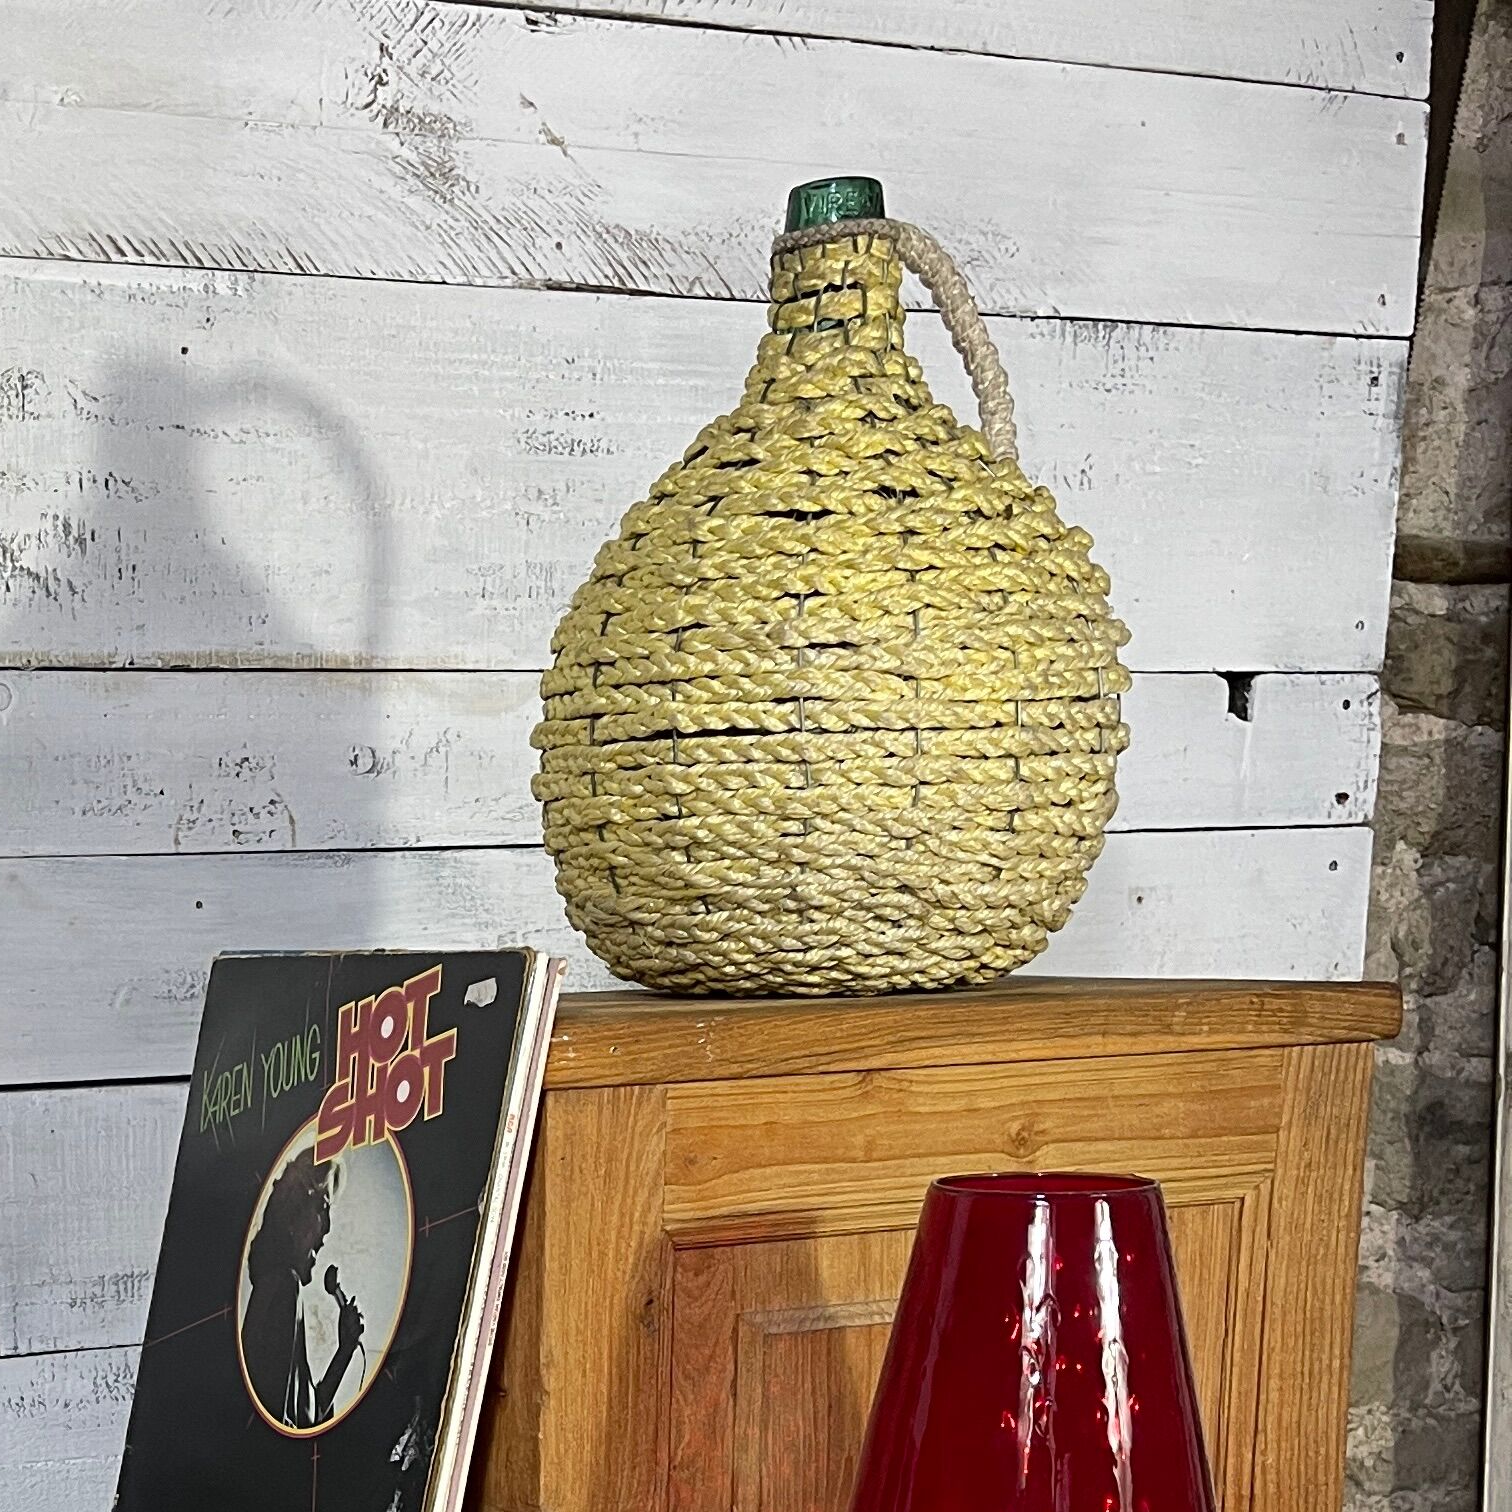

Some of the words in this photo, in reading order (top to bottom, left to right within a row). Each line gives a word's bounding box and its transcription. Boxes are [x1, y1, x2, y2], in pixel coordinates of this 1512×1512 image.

[200, 1045, 256, 1138] KAREN
[261, 1010, 321, 1111] YOUNG
[336, 963, 442, 1084] HOT
[314, 1027, 457, 1166] SHOT
